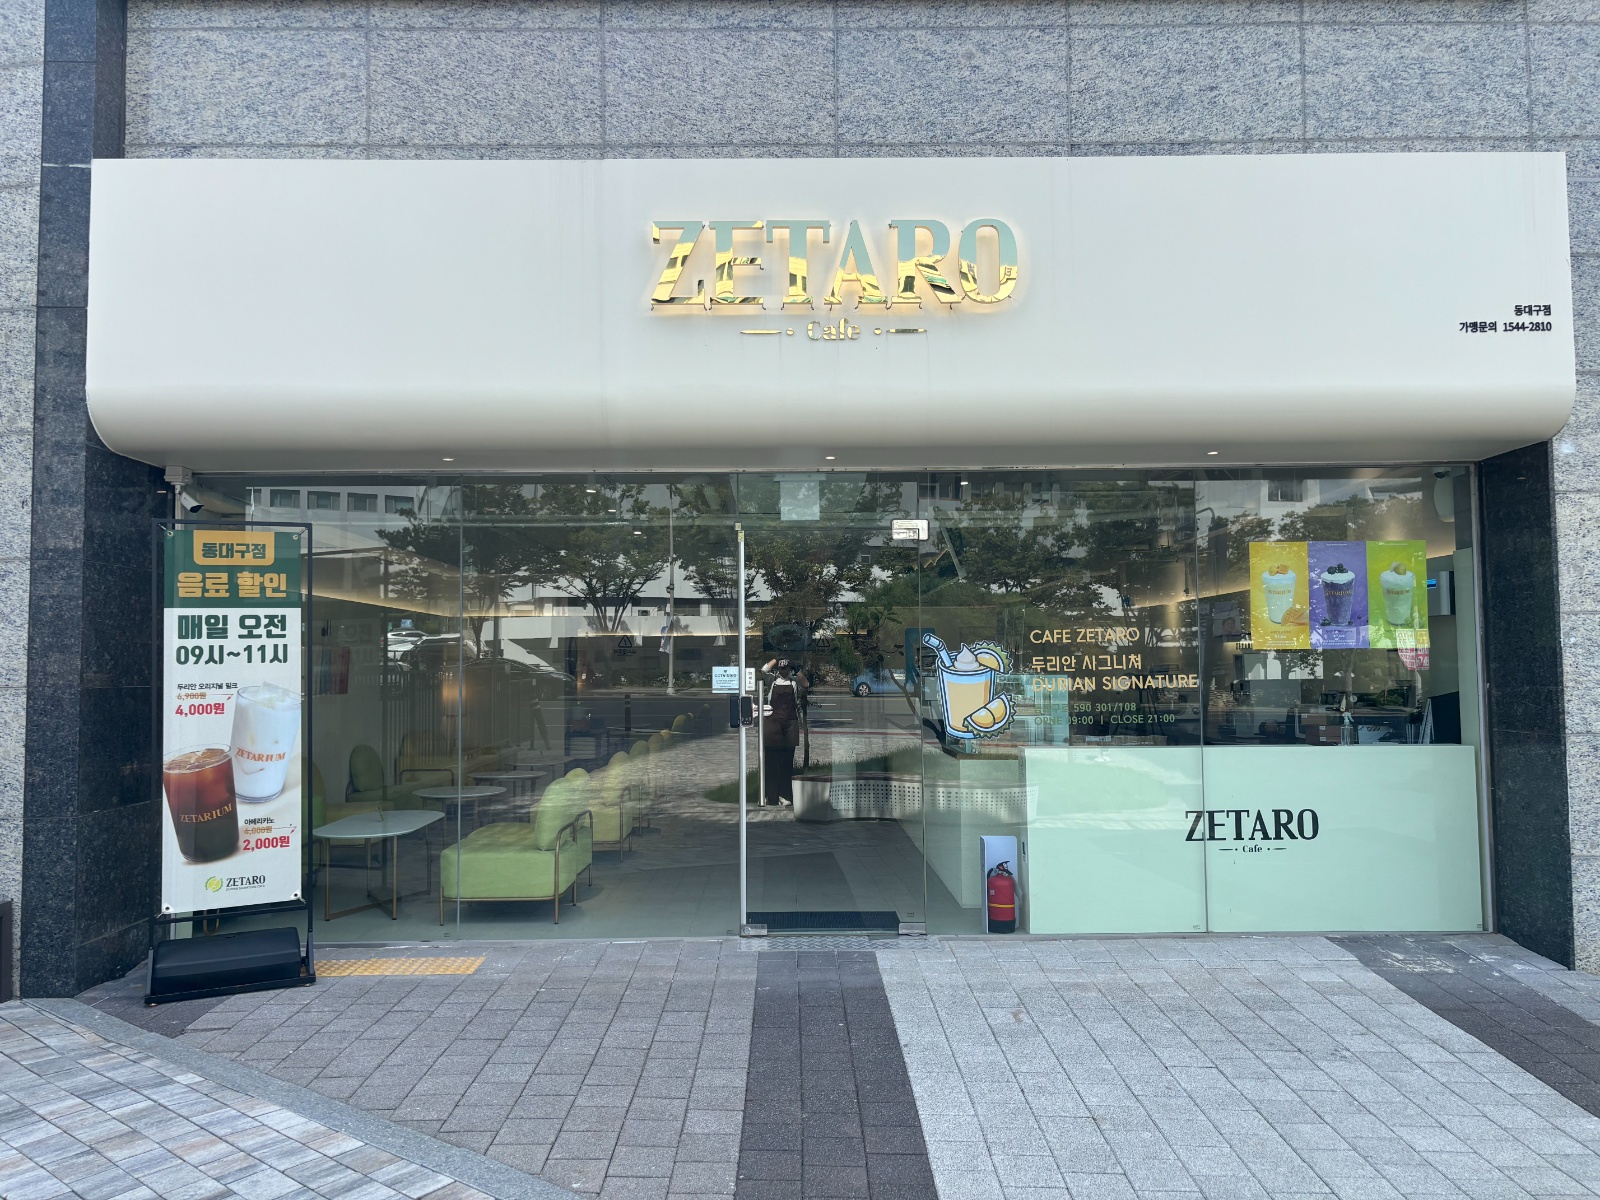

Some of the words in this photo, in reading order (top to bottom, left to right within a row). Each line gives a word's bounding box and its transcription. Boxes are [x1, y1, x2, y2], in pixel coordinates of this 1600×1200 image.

[651, 218, 1018, 305] ZETARO
[1514, 304, 1552, 317] 동대구점
[807, 318, 861, 341] Cafe
[1459, 321, 1498, 333] 가맹문의
[1503, 321, 1552, 332] 1544-2810
[201, 542, 266, 559] 동대구점
[177, 572, 230, 598] 음료
[237, 571, 287, 598] 할인
[177, 614, 229, 640] 매일
[238, 614, 287, 639] 오전
[1029, 630, 1072, 644] CAFE
[1076, 627, 1140, 643] ZETARO
[175, 643, 288, 665] 09시~11시
[1031, 656, 1077, 672] 두리안
[198, 682, 224, 690] 오리지널
[225, 682, 238, 690] 밀크
[1032, 677, 1096, 692] DURIAN
[1102, 674, 1198, 690] SIGNATURE
[175, 702, 225, 717] 4,000원
[1073, 703, 1092, 712] 590
[1095, 702, 1137, 712] 301/108
[1066, 715, 1094, 725] 09:00
[1110, 714, 1144, 724] CLOSE
[1147, 714, 1176, 723] 21:00
[236, 747, 286, 762] ZETARIUM
[180, 803, 232, 823] ZETARIUM
[244, 817, 275, 825] 아메리카노
[1185, 808, 1320, 842] ZETARO
[242, 835, 290, 852] 2,000원
[1242, 844, 1263, 853] Cafe
[226, 874, 266, 888] ZETARO
